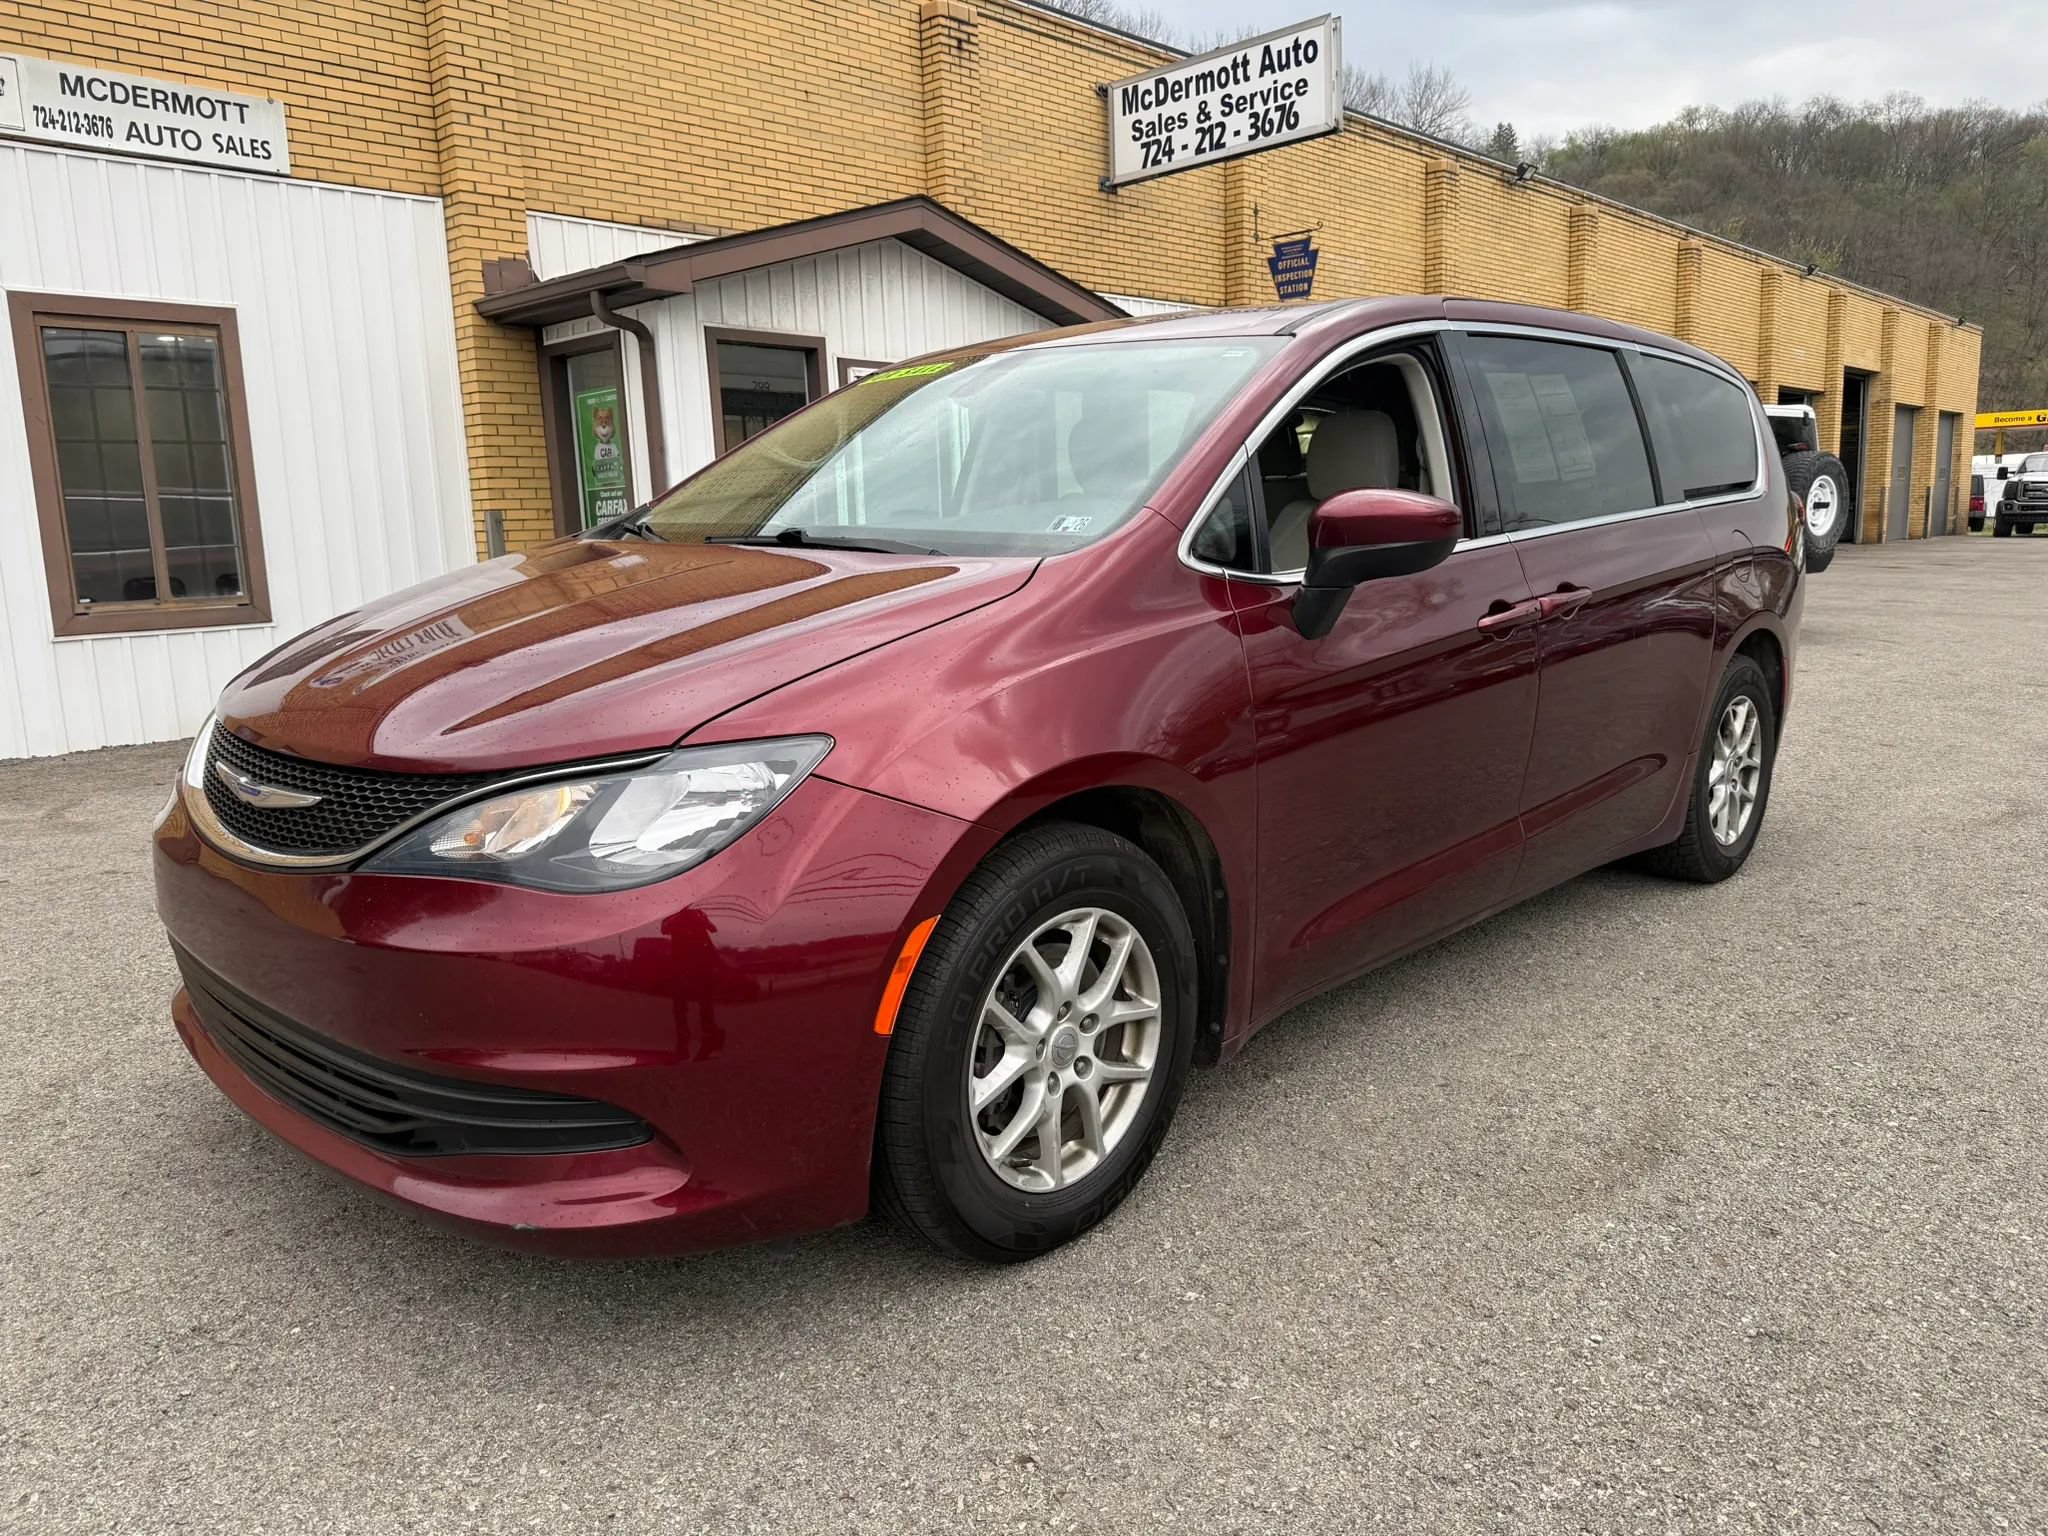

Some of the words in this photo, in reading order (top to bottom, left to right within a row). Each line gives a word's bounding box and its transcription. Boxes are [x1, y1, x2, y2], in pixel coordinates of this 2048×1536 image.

[59, 72, 249, 124] MCDERMOTT
[1121, 52, 1250, 117] McDermott
[1258, 36, 1318, 79] Auto
[32, 105, 114, 139] 724-212-3676
[125, 121, 202, 152] AUTO
[212, 133, 272, 160] SALES
[1131, 111, 1188, 142] Sales
[1196, 100, 1212, 125] &
[1220, 77, 1308, 118] Service
[1140, 135, 1175, 169] 724
[1195, 121, 1227, 156] 212
[1248, 101, 1299, 142] 3676
[1274, 269, 1313, 283] INSPECTION
[1278, 256, 1309, 270] OFFICIAL
[1280, 282, 1308, 295] STATION
[596, 498, 628, 517] CARFAX
[968, 903, 1027, 984] PRO
